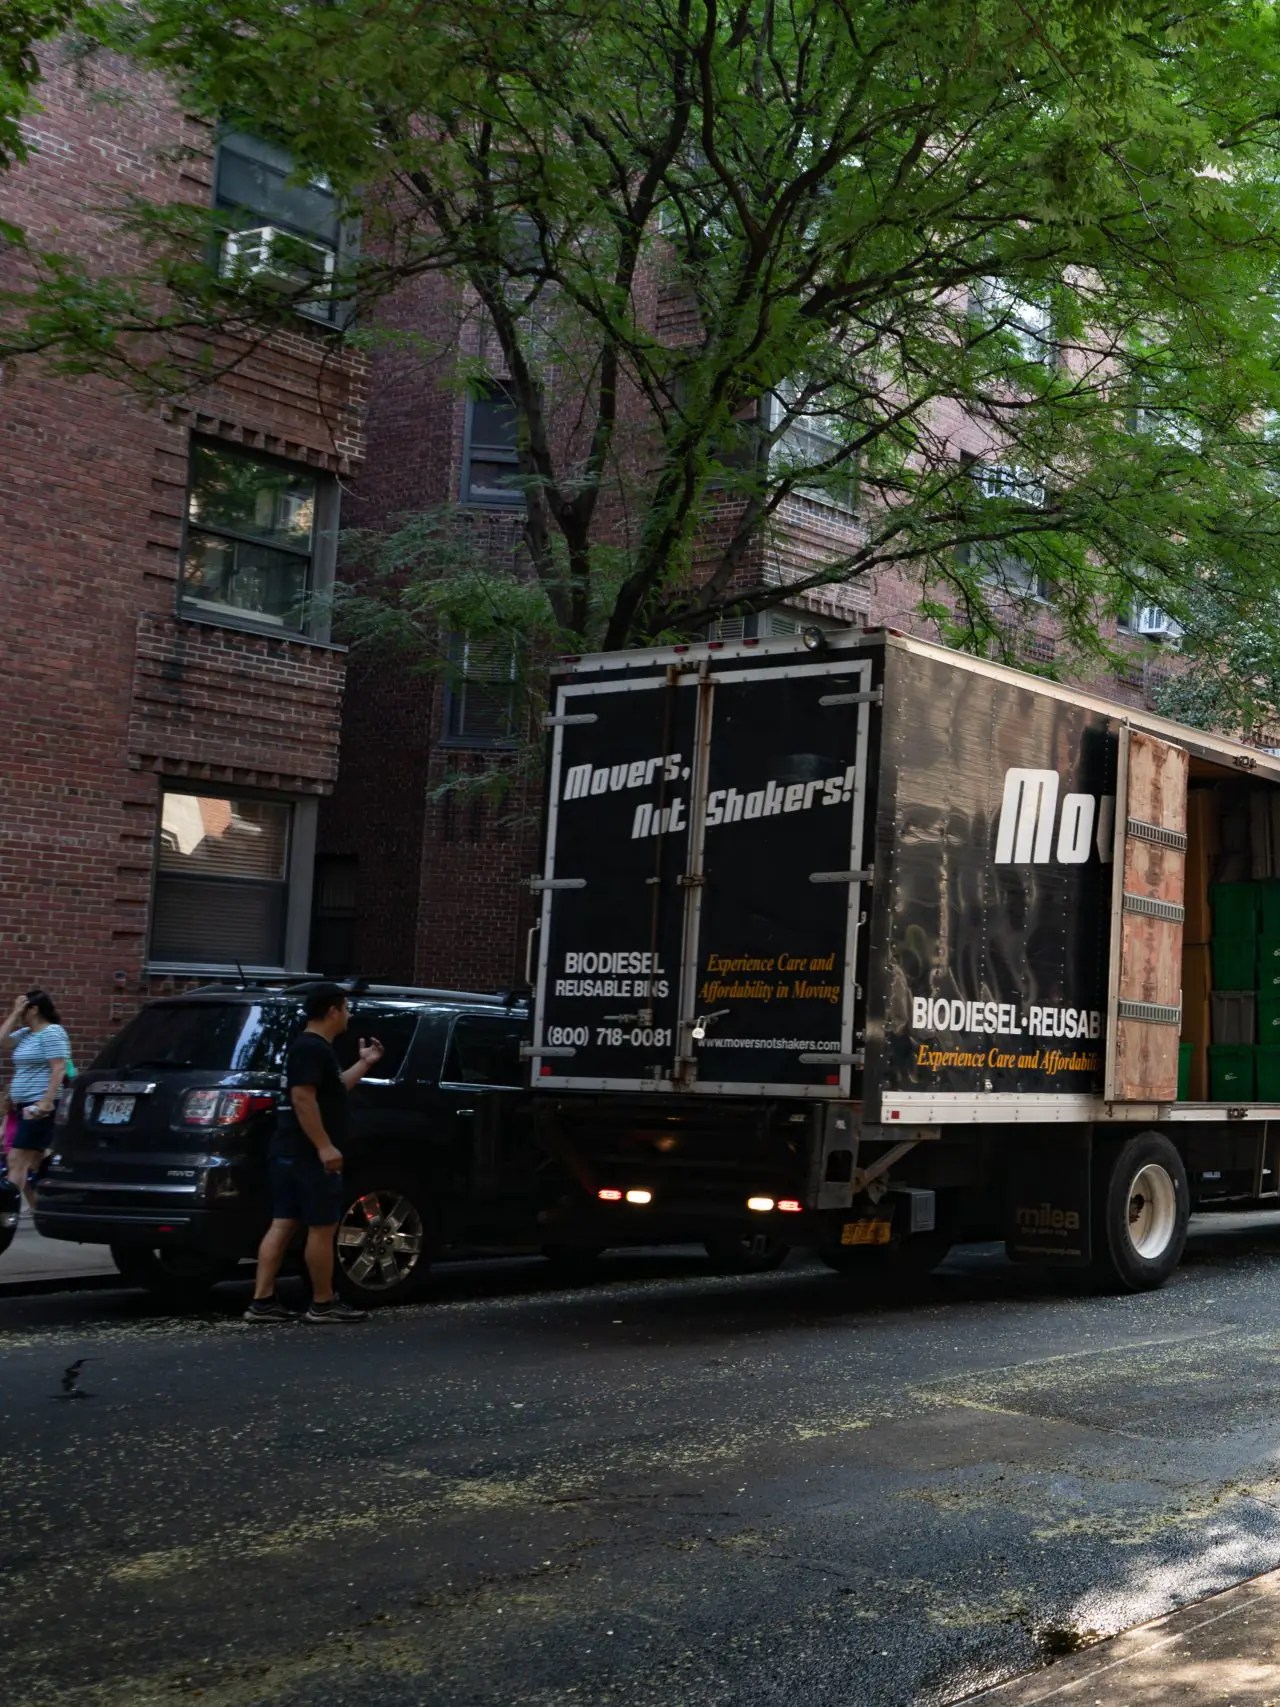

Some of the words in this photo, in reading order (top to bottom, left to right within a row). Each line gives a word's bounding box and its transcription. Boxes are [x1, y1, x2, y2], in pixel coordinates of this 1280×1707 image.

[564, 753, 690, 800] Movers,
[631, 798, 686, 839] Not
[705, 766, 856, 827] Shakers!
[565, 952, 665, 974] BIODIESEL
[706, 953, 774, 976] Experience
[777, 953, 807, 971] Care
[810, 952, 836, 971] and
[555, 980, 631, 997] REUSABLE
[634, 980, 669, 997] BINS
[698, 980, 774, 1003] Affordability
[776, 981, 790, 998] in
[791, 980, 840, 1004] Moving
[912, 996, 1022, 1035] BIODIESEL
[547, 1025, 590, 1047] (800)
[596, 1028, 673, 1047] 718-0081
[698, 1038, 840, 1051] www.moversnotshakers.com
[917, 1045, 985, 1071] Experience
[988, 1047, 1014, 1068] Care
[1017, 1049, 1040, 1069] and
[1016, 1203, 1081, 1230] milea
